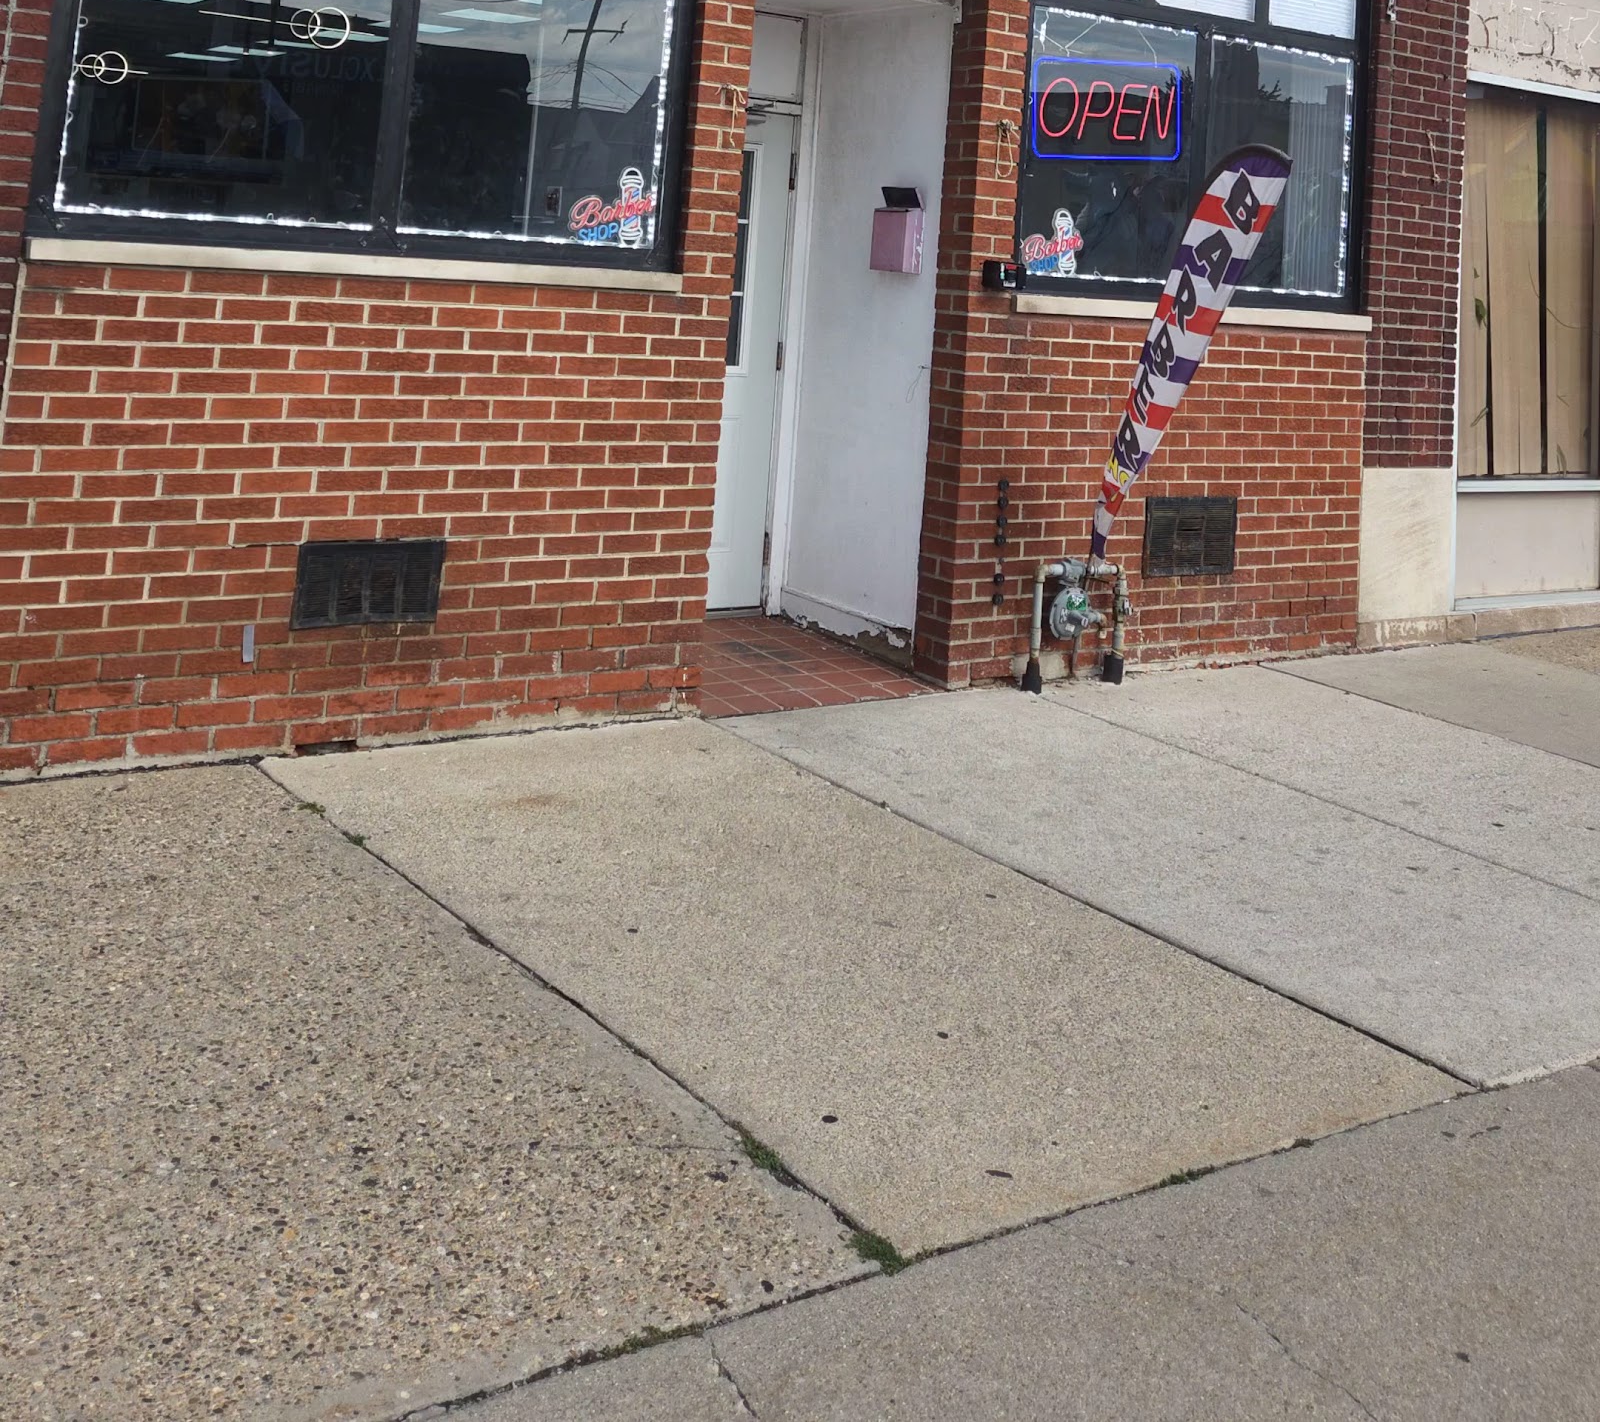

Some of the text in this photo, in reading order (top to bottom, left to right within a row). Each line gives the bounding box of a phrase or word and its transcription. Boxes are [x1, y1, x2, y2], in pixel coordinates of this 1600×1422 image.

[1040, 78, 1175, 140] OPEN
[569, 194, 653, 230] Barber
[579, 224, 618, 241] SHOP
[1024, 233, 1082, 262] Barber
[1030, 255, 1058, 273] SHOP
[1116, 168, 1260, 474] BARBER
